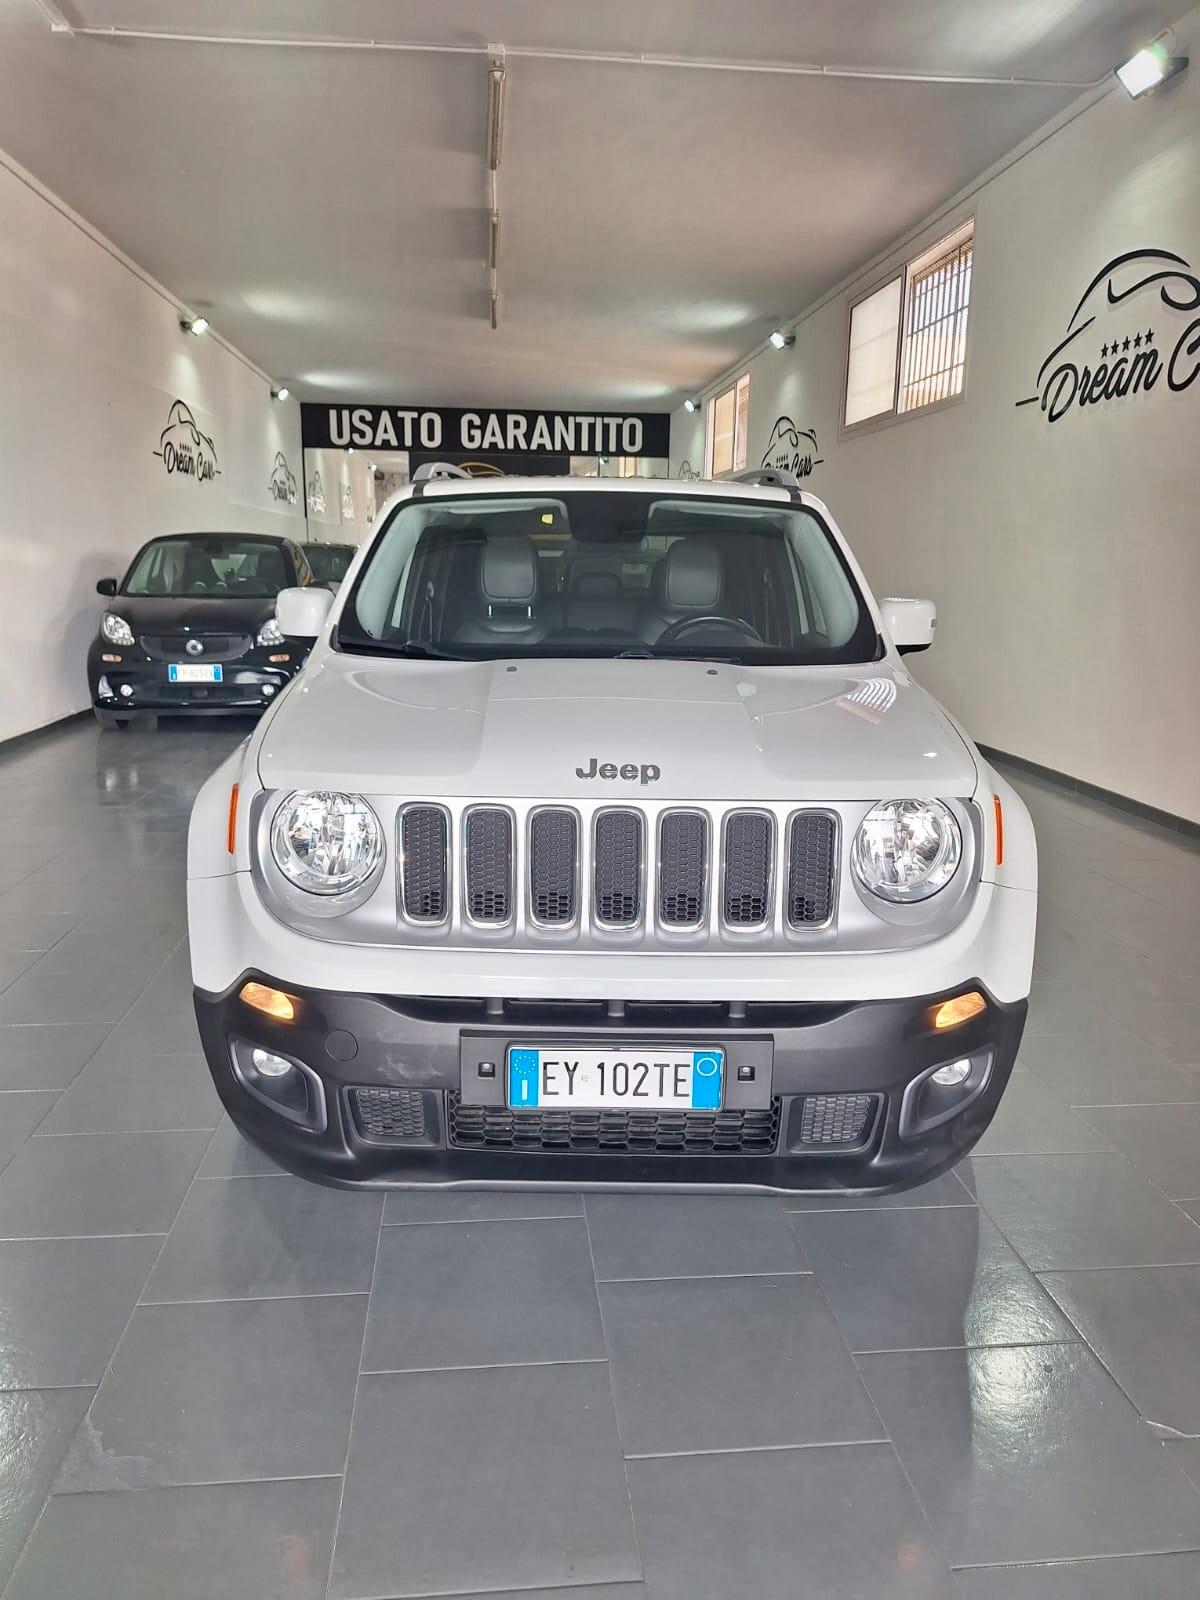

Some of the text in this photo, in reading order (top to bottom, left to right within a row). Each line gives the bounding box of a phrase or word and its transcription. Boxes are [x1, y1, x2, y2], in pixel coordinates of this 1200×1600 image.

[1041, 317, 1200, 423] Dream C
[328, 408, 644, 453] USATO GARANTITO
[163, 441, 196, 477] Dream
[575, 758, 661, 785] Jeep
[542, 1061, 691, 1098] EY 102TE
